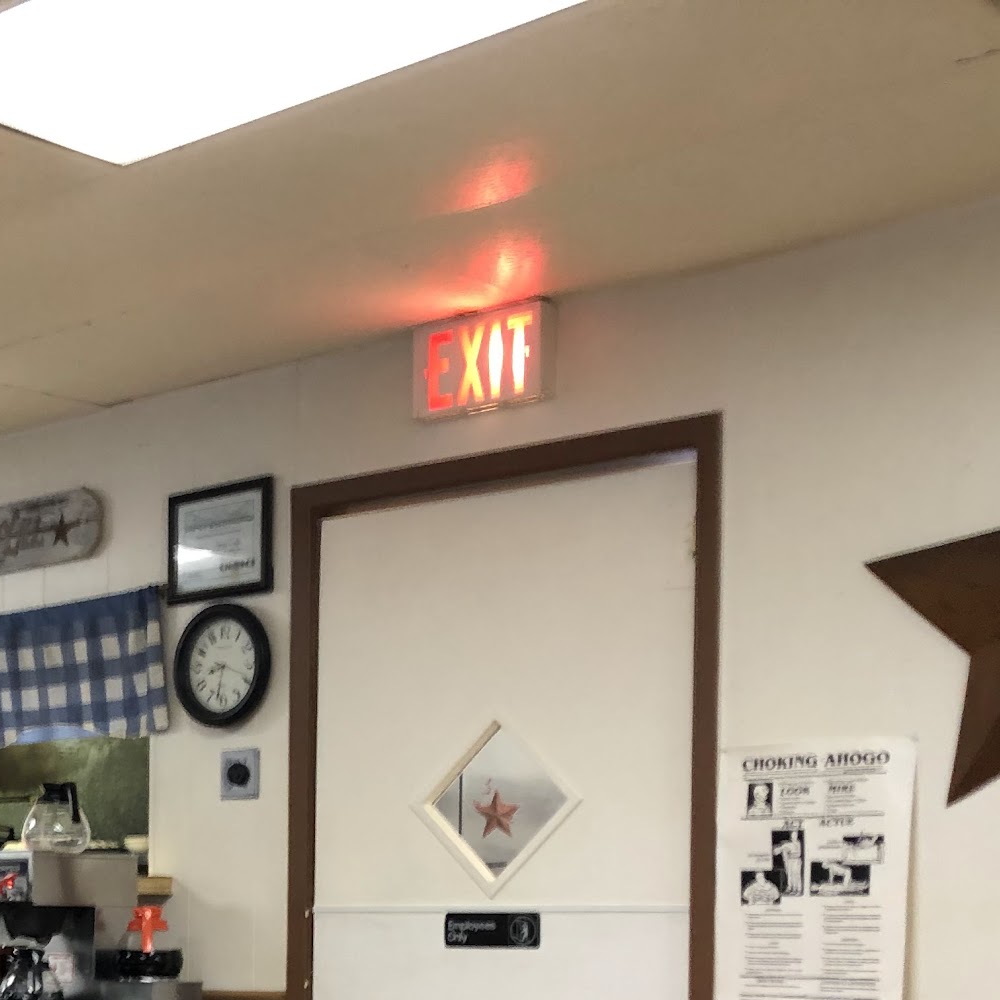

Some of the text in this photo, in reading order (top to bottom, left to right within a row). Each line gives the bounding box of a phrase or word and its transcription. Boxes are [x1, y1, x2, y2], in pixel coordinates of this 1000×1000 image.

[425, 311, 533, 412] EXIT
[742, 750, 891, 772] CHOKING AHOGO
